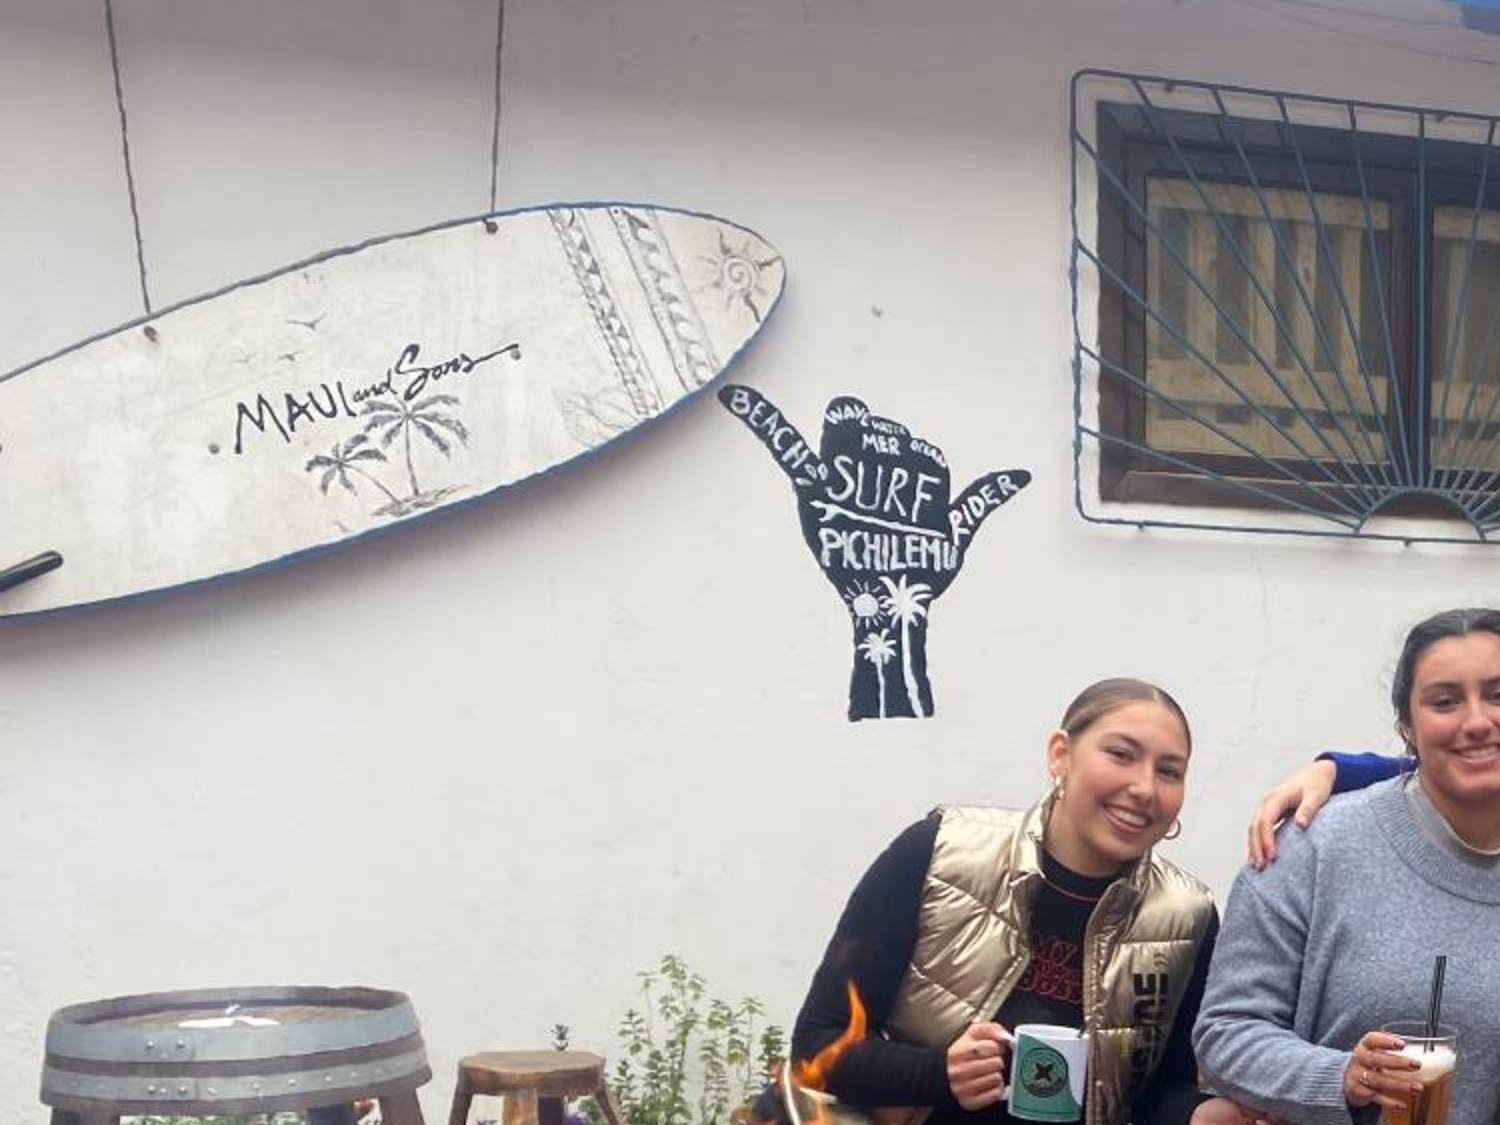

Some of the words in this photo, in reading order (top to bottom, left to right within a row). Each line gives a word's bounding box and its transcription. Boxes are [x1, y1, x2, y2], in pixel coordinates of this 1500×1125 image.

[234, 381, 357, 454] MAUI
[351, 370, 397, 404] and
[394, 343, 519, 401] Sons
[730, 388, 810, 470] BEACH
[871, 420, 908, 436] WATER
[861, 433, 901, 456] MER
[824, 455, 941, 523] SURF
[948, 474, 1018, 546] RIDER
[818, 527, 960, 573] PICHILEMU
